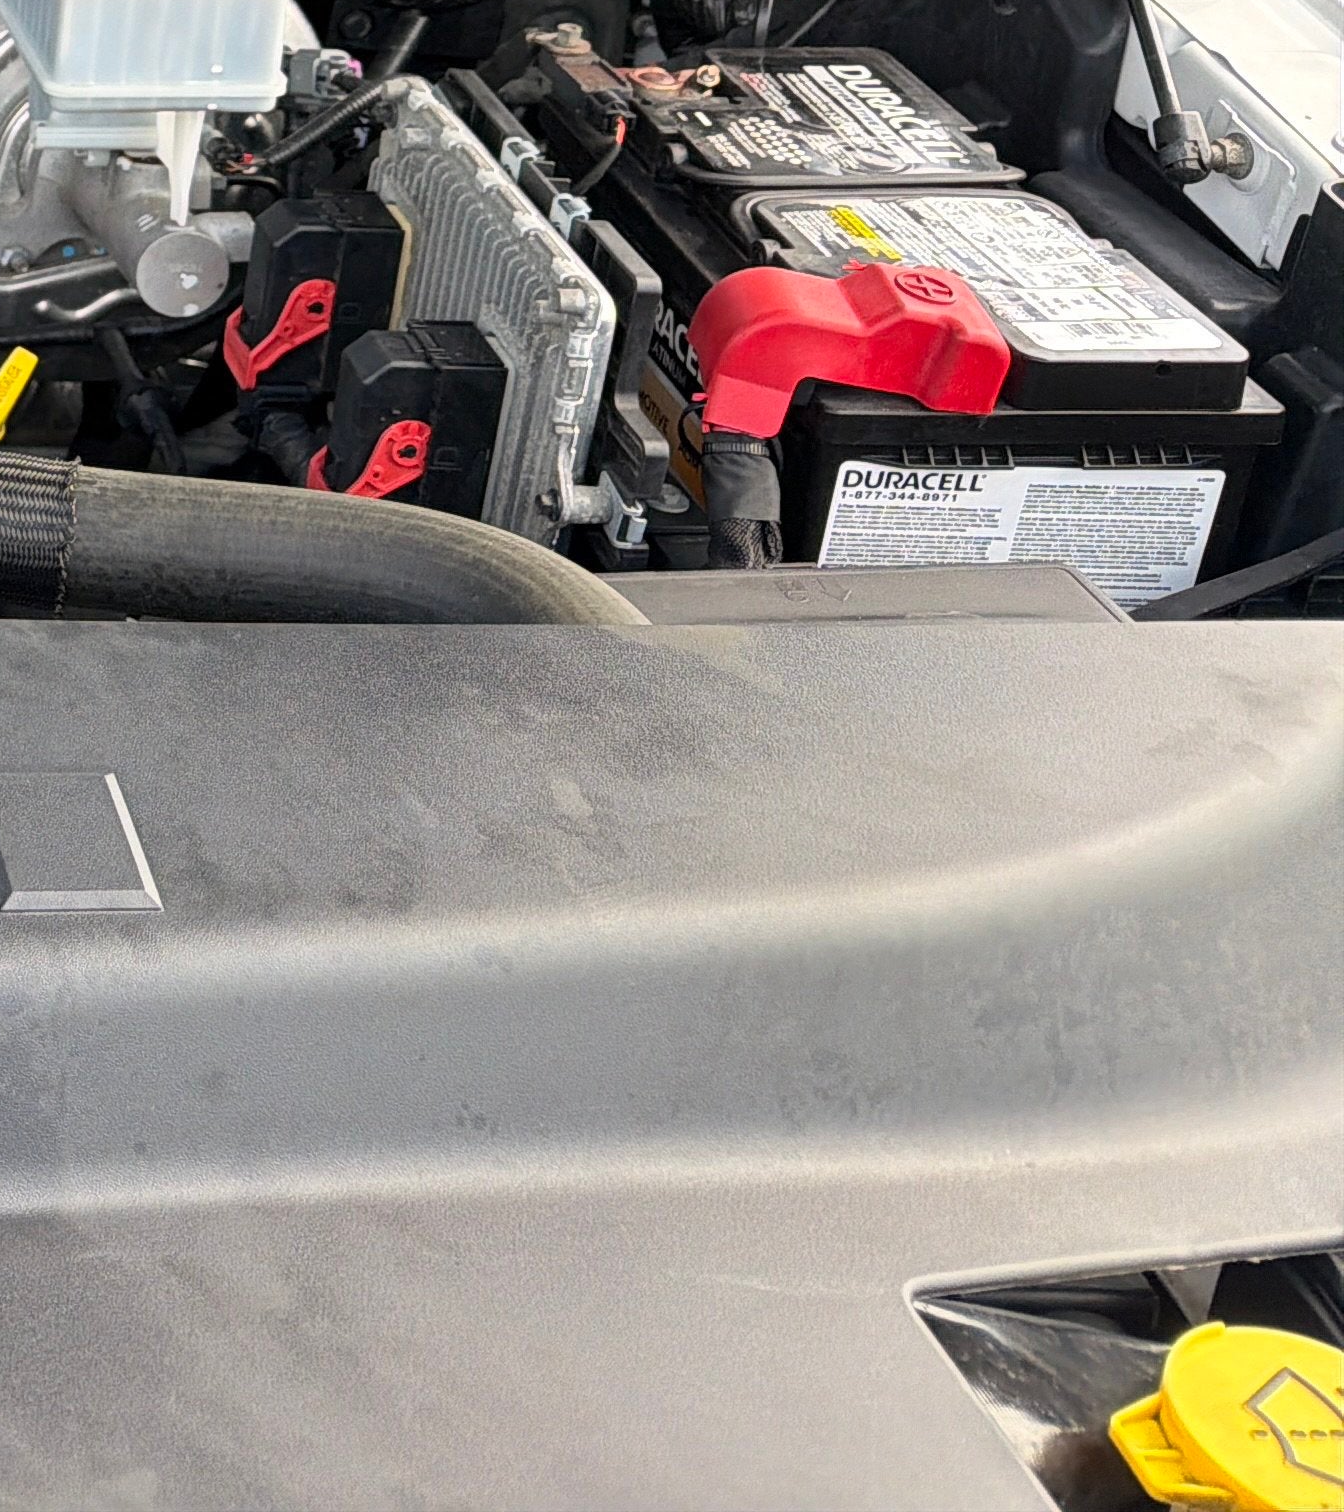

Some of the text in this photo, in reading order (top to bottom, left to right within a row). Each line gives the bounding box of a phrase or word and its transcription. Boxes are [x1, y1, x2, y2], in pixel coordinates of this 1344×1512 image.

[827, 64, 966, 164] DURACELL
[654, 301, 704, 387] RACE
[839, 489, 959, 503] 1-877-344-8971
[842, 469, 984, 492] DURACELL
